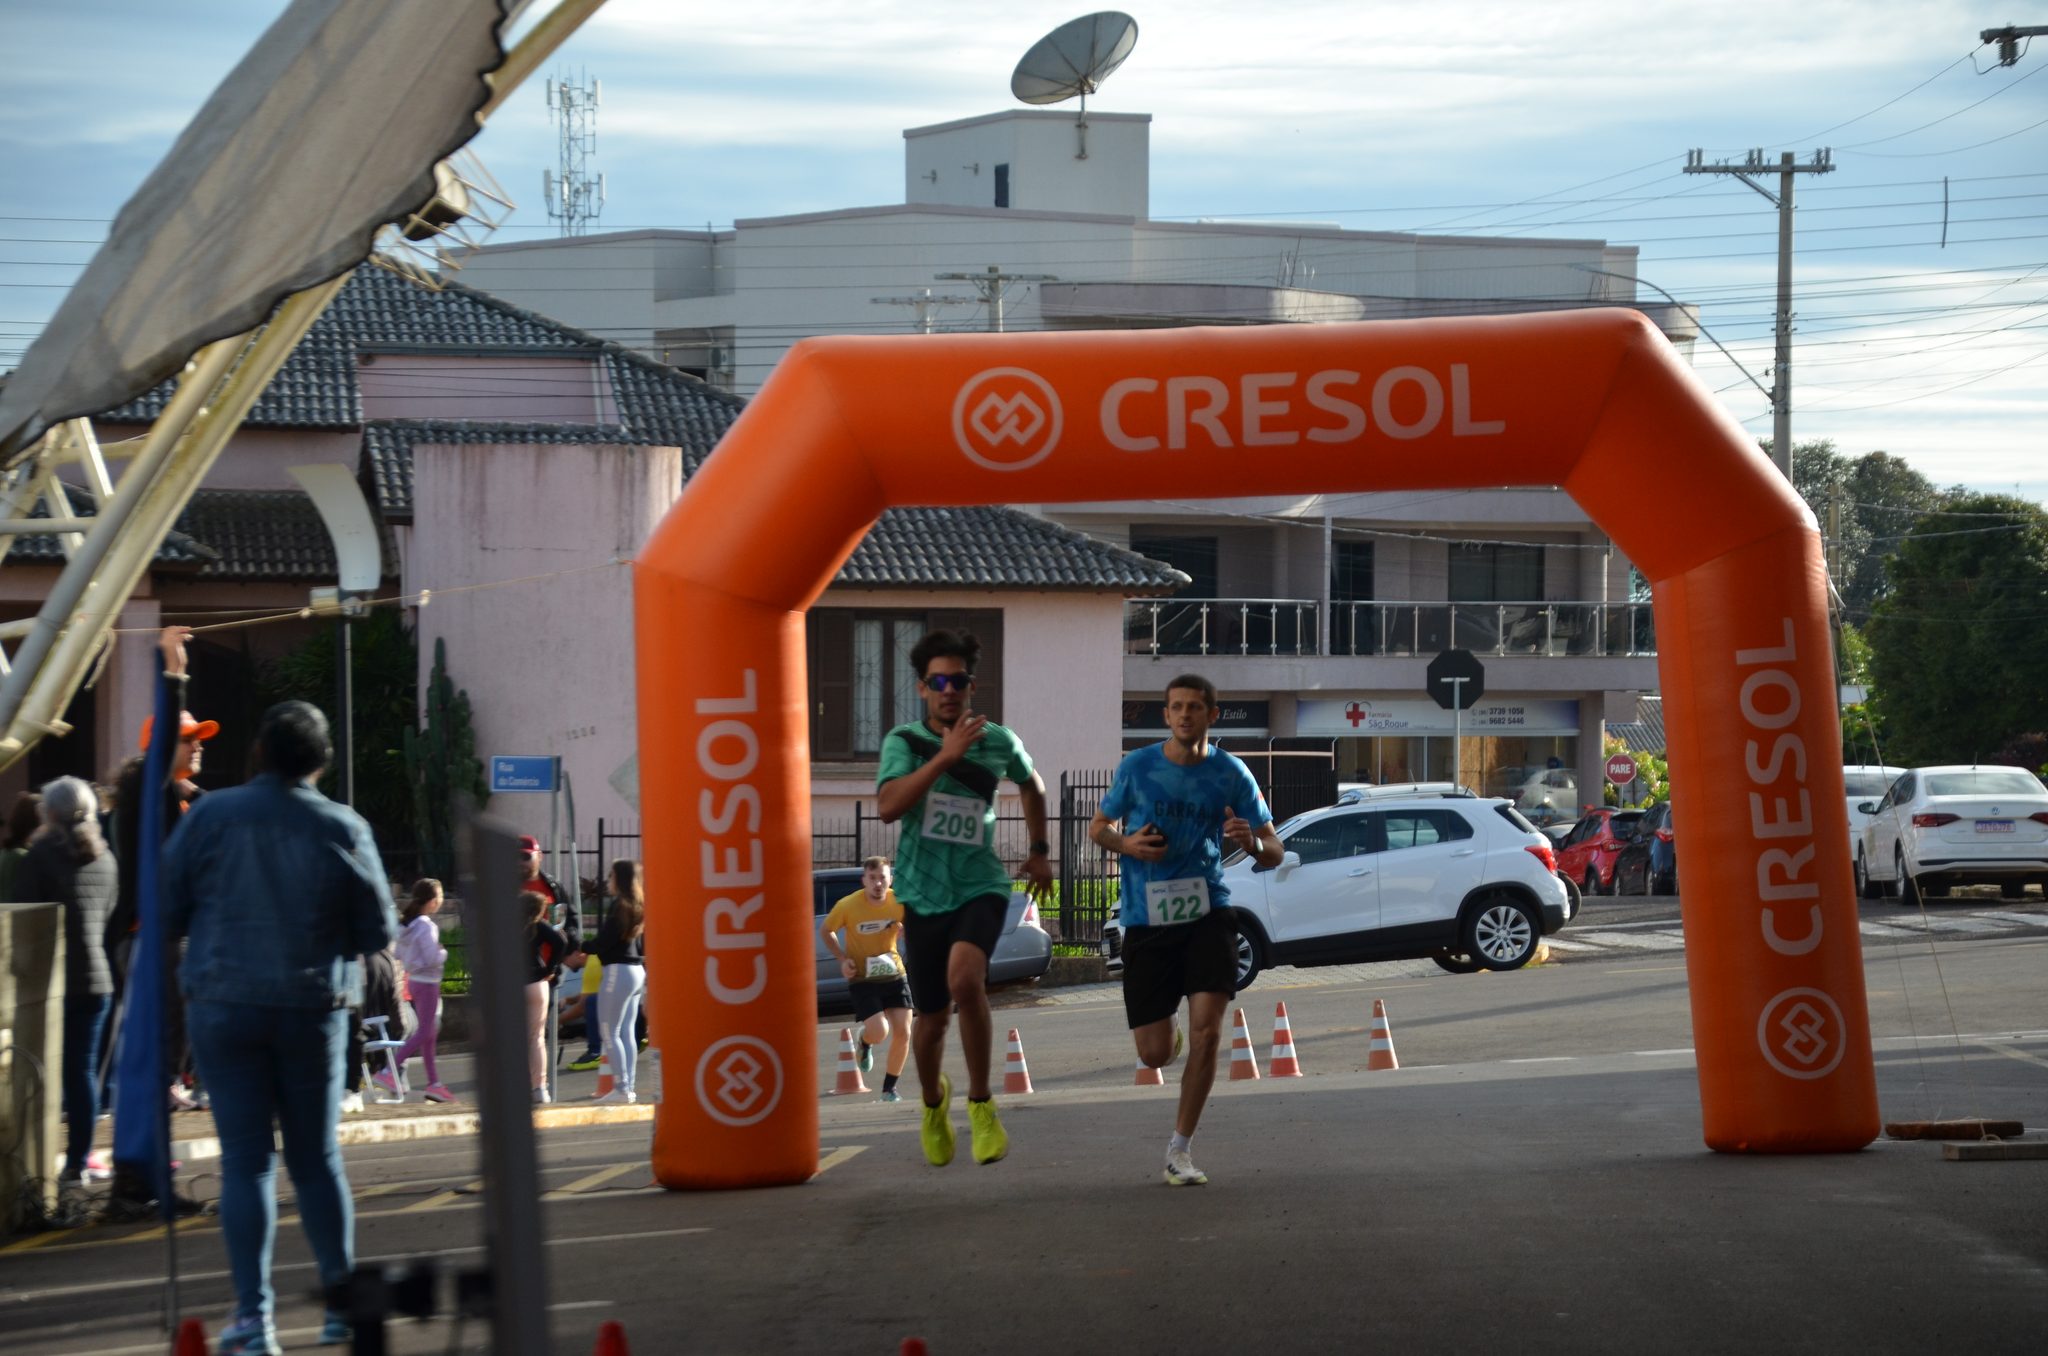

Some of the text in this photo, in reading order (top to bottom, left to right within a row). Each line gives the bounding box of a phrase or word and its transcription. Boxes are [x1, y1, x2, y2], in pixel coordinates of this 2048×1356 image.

[1100, 363, 1506, 452] CRESOL
[1222, 709, 1248, 720] Estilo
[1368, 718, 1383, 728] São
[1383, 719, 1409, 729] Roque
[498, 761, 515, 772] Rua
[1610, 764, 1631, 774] PARE
[1735, 616, 1823, 956] CRESOL
[695, 668, 768, 1005] CRESOL
[931, 810, 977, 840] 209
[1157, 894, 1202, 922] 122
